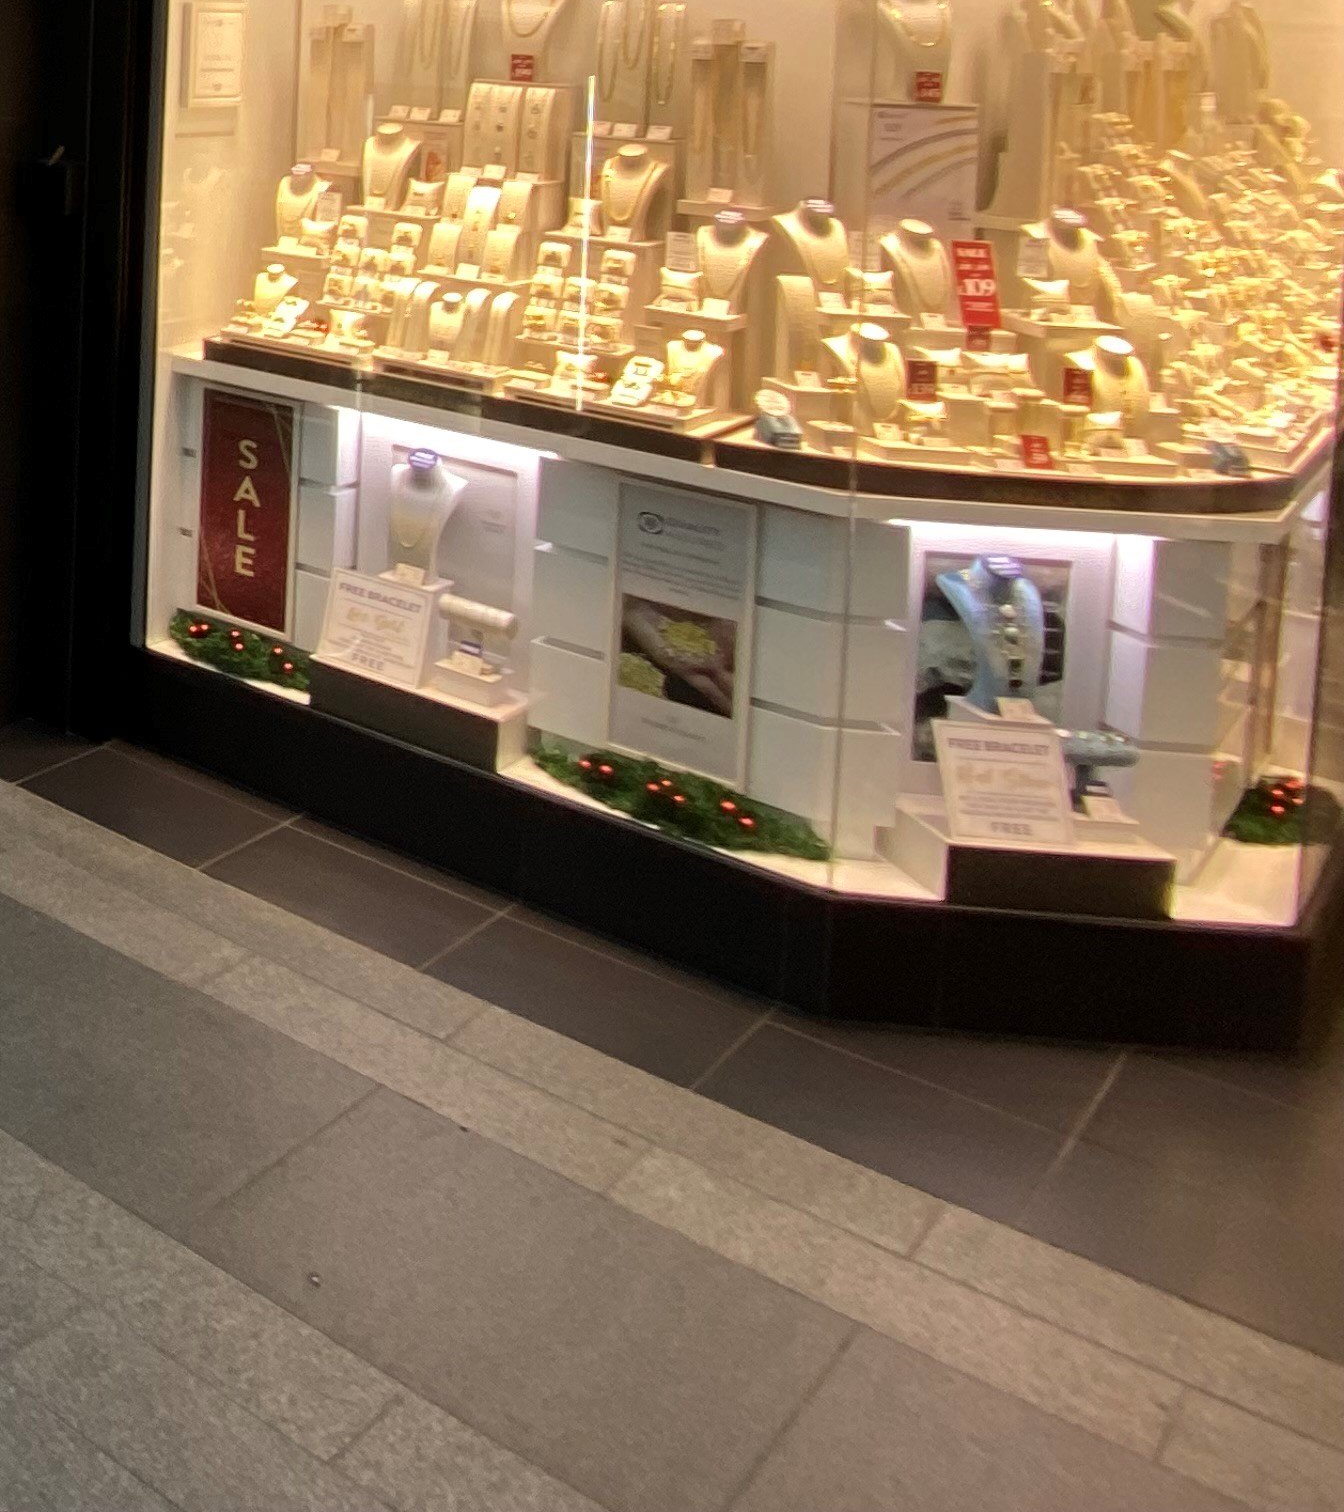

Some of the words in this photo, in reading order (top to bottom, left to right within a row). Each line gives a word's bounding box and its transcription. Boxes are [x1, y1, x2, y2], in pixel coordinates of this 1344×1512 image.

[233, 438, 261, 577] SALE
[367, 590, 422, 614] BRACELET
[983, 740, 1050, 757] BRACELET
